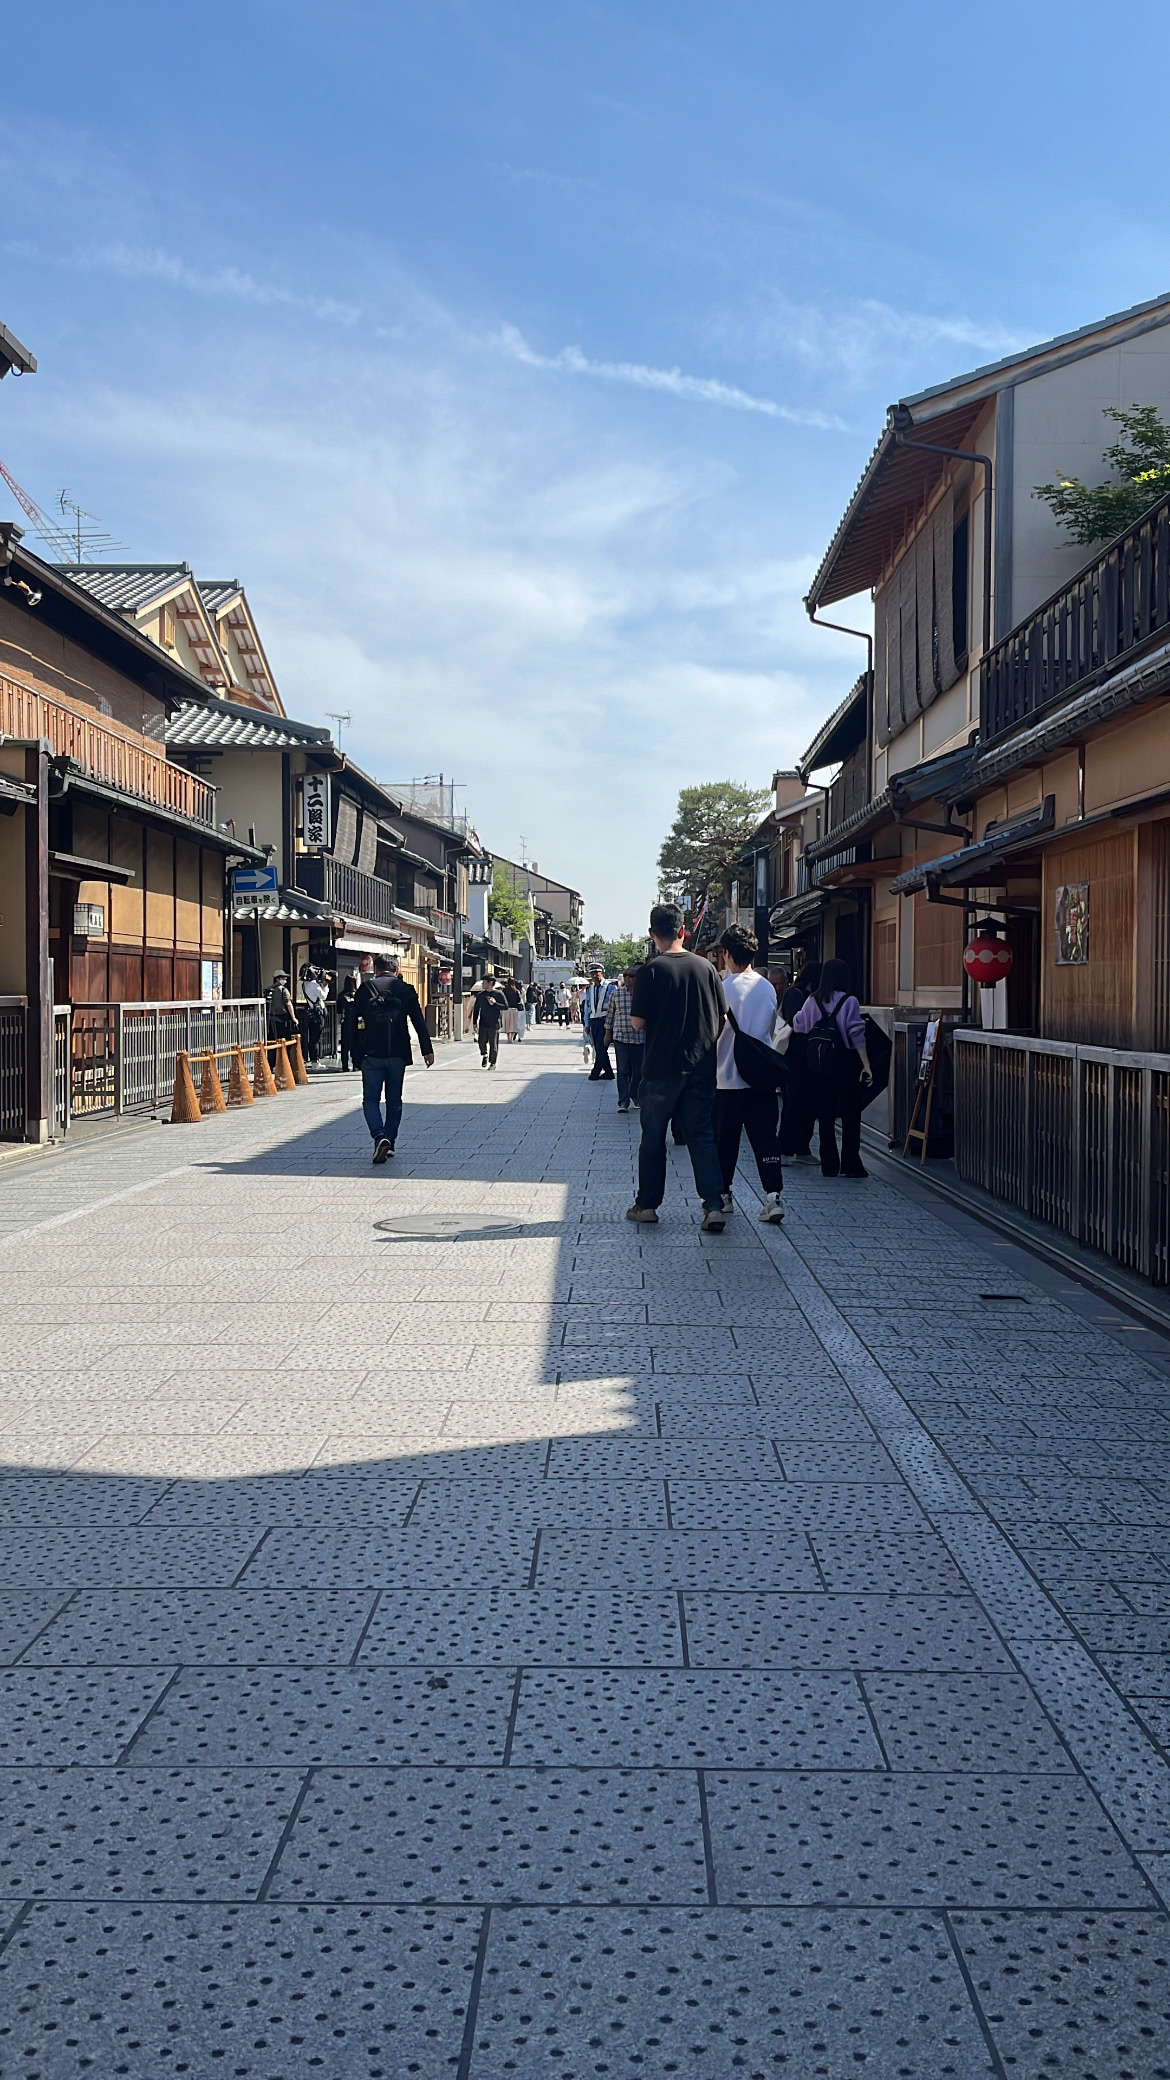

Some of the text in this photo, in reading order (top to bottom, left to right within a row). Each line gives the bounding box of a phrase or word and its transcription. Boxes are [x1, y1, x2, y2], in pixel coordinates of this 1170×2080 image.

[236, 894, 276, 906] 自転車を除く
